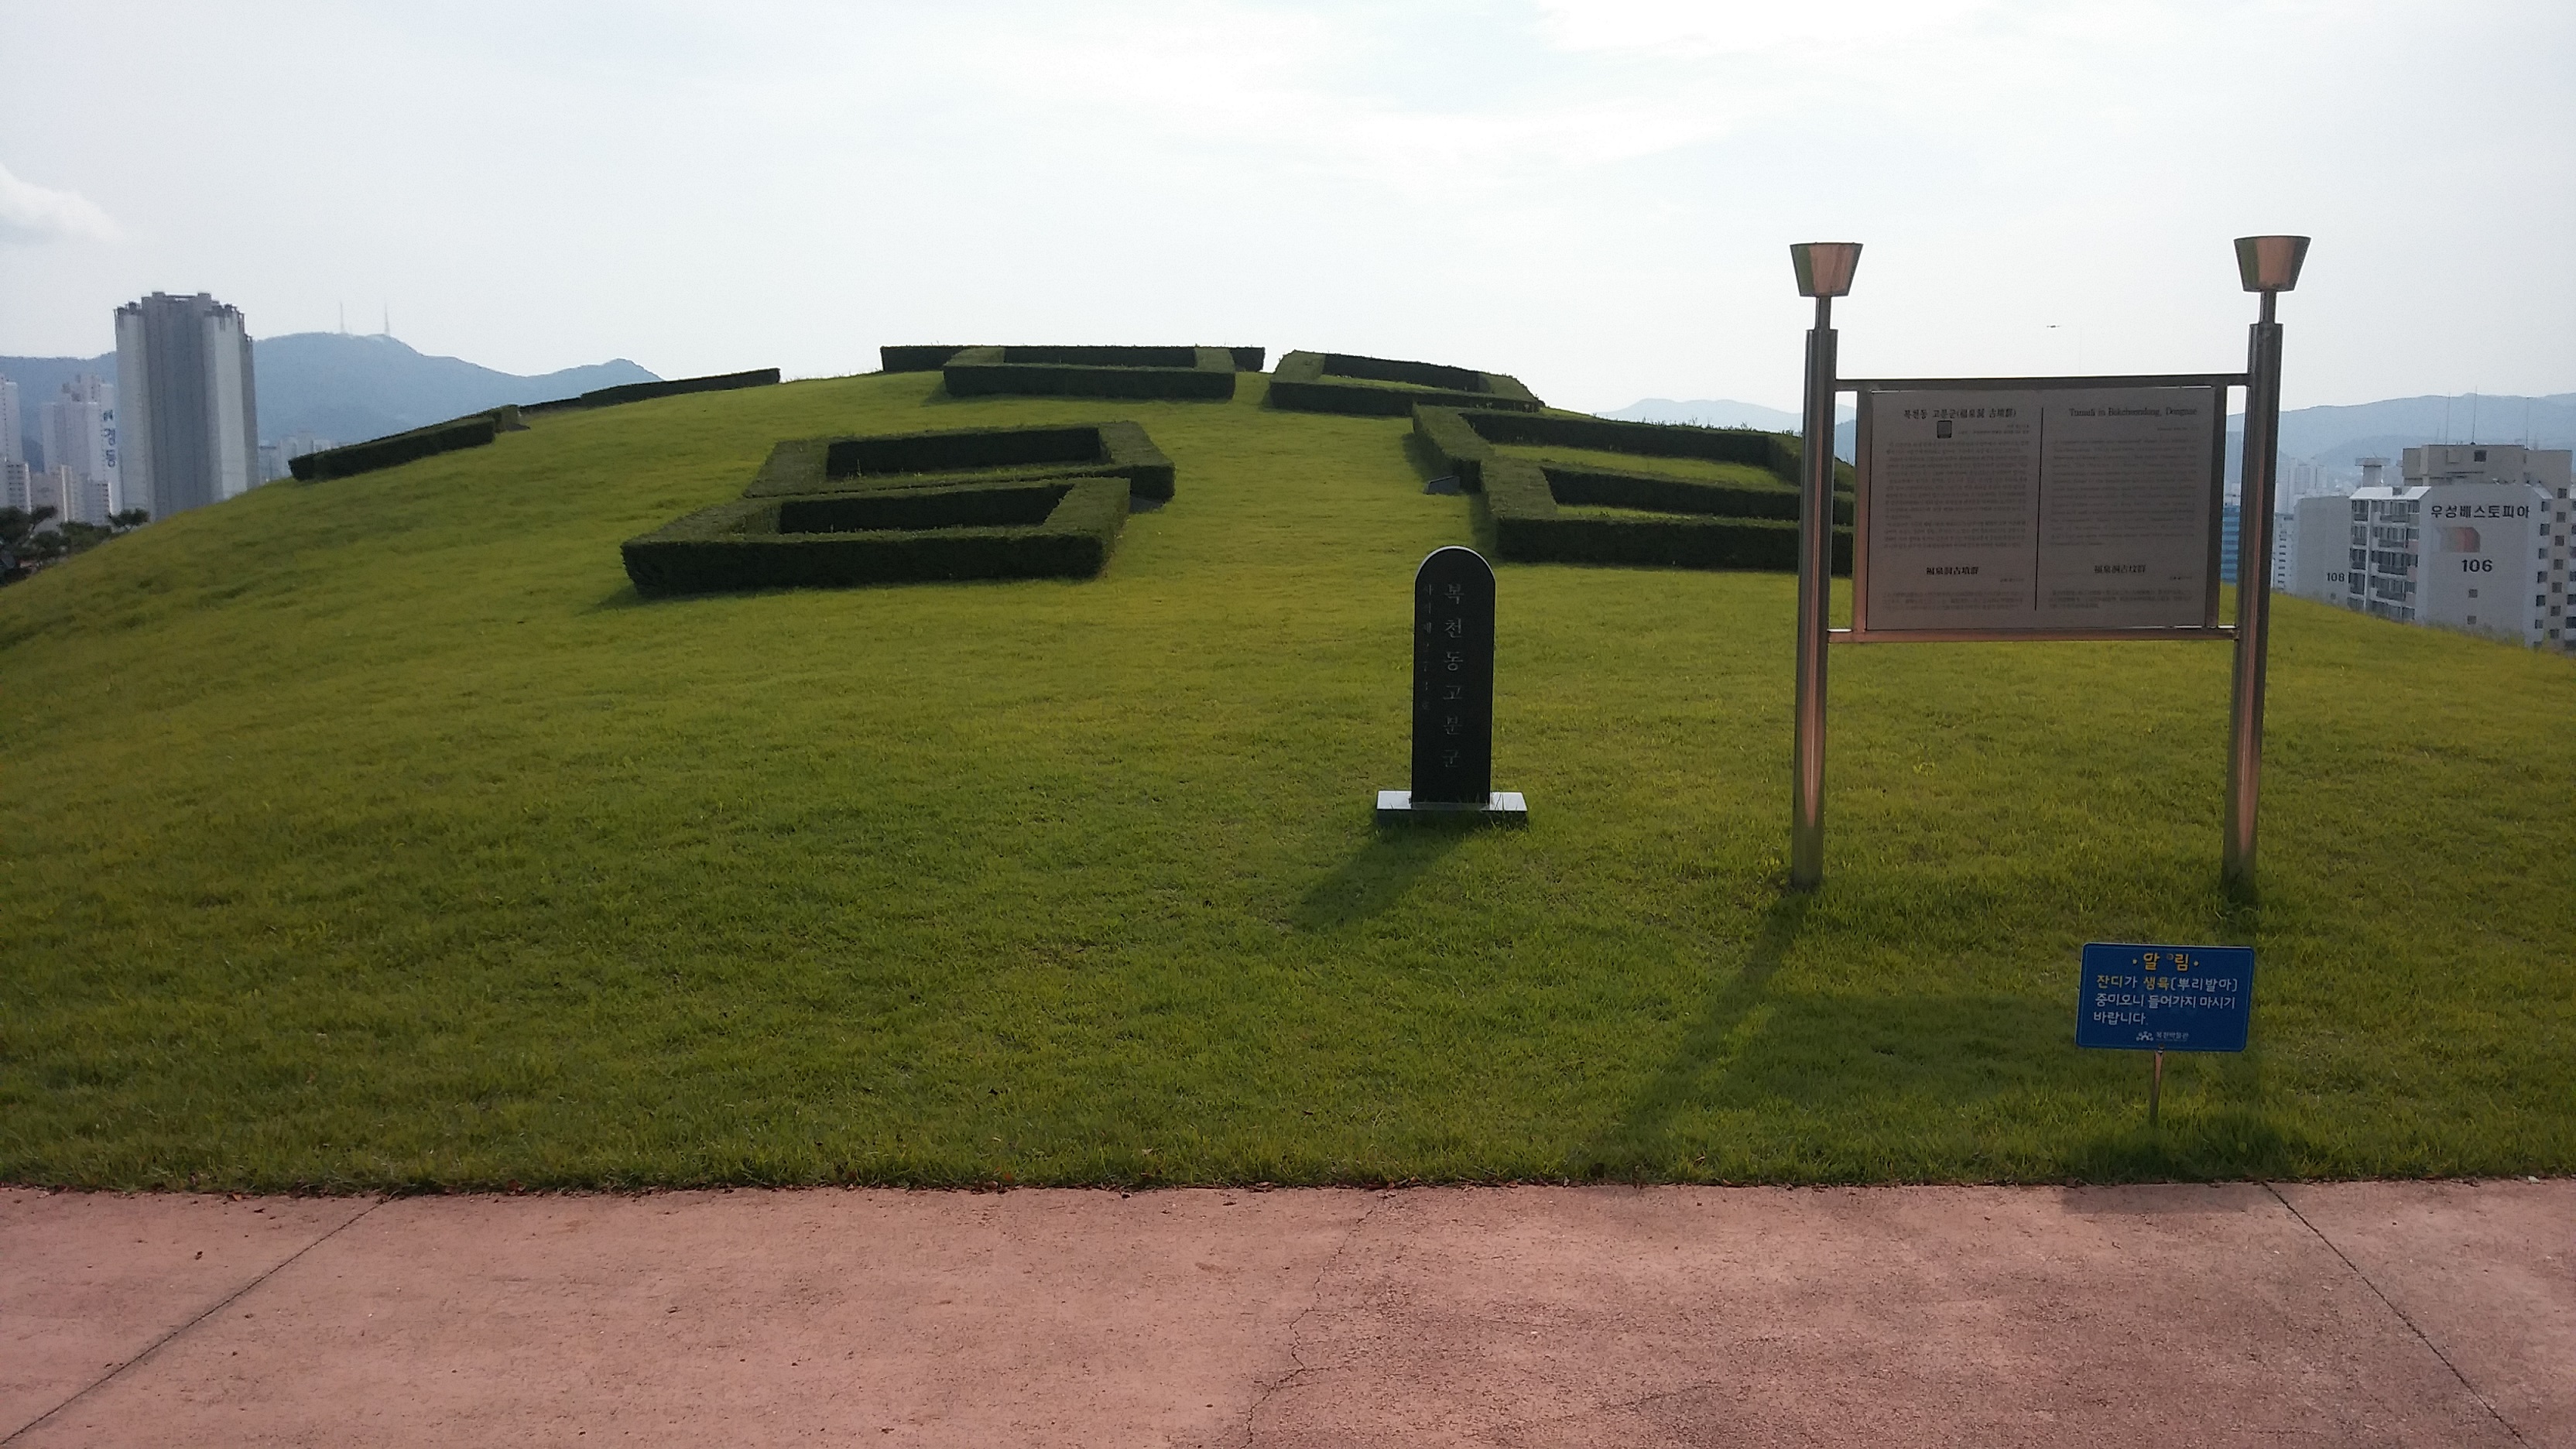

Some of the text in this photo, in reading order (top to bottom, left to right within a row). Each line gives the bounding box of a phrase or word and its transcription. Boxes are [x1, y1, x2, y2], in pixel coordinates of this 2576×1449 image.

[2098, 408, 2105, 416] in
[2430, 505, 2530, 519] 우성베스토피아
[2461, 558, 2493, 573] 106
[2326, 571, 2345, 582] 108
[2096, 975, 2138, 989] 잔디가
[2095, 992, 2235, 1009] 중이오니 들어가지 마시기
